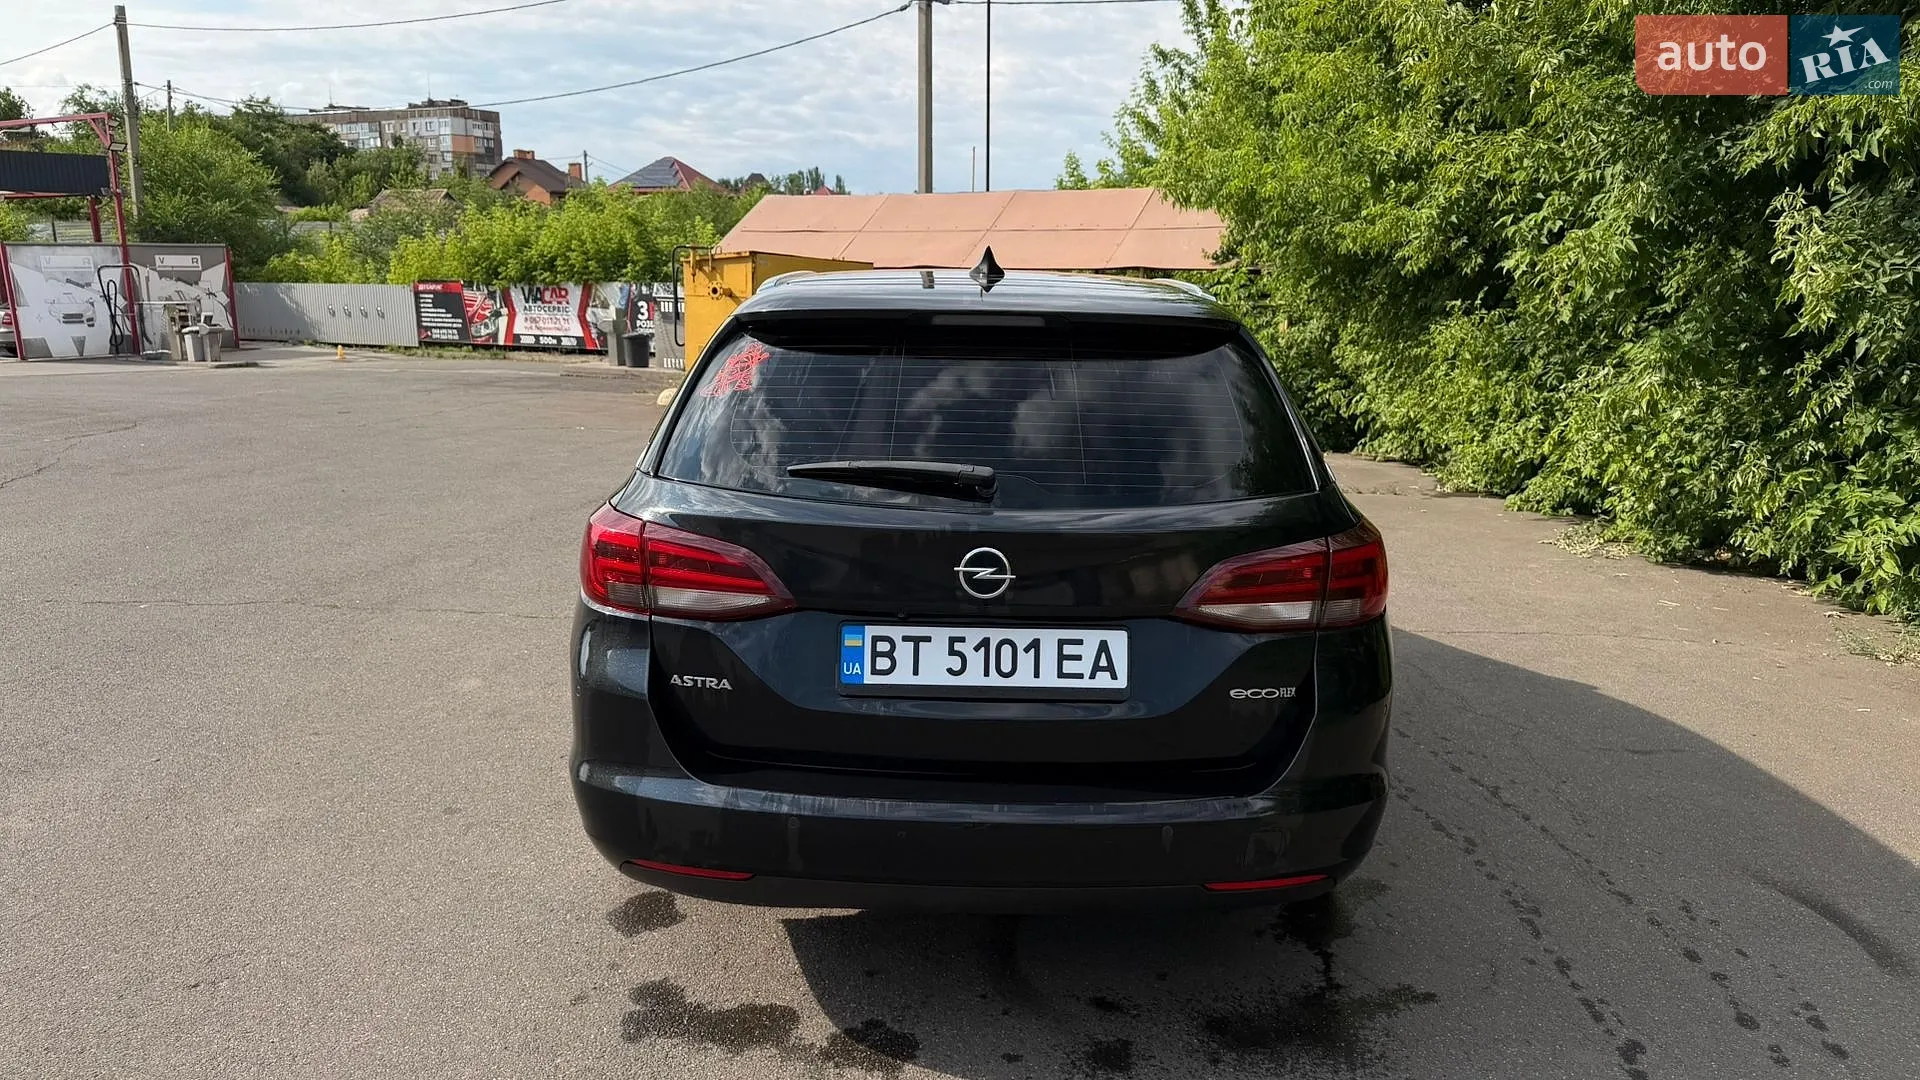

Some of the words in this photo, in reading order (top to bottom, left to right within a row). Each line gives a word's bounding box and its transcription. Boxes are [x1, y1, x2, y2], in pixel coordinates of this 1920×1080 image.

[523, 305, 570, 313] АВТОСЕРВІС
[870, 635, 932, 676] BT
[945, 636, 1041, 679] 5101
[1057, 638, 1118, 681] EA
[843, 662, 861, 675] UA
[670, 674, 733, 690] ASTRA
